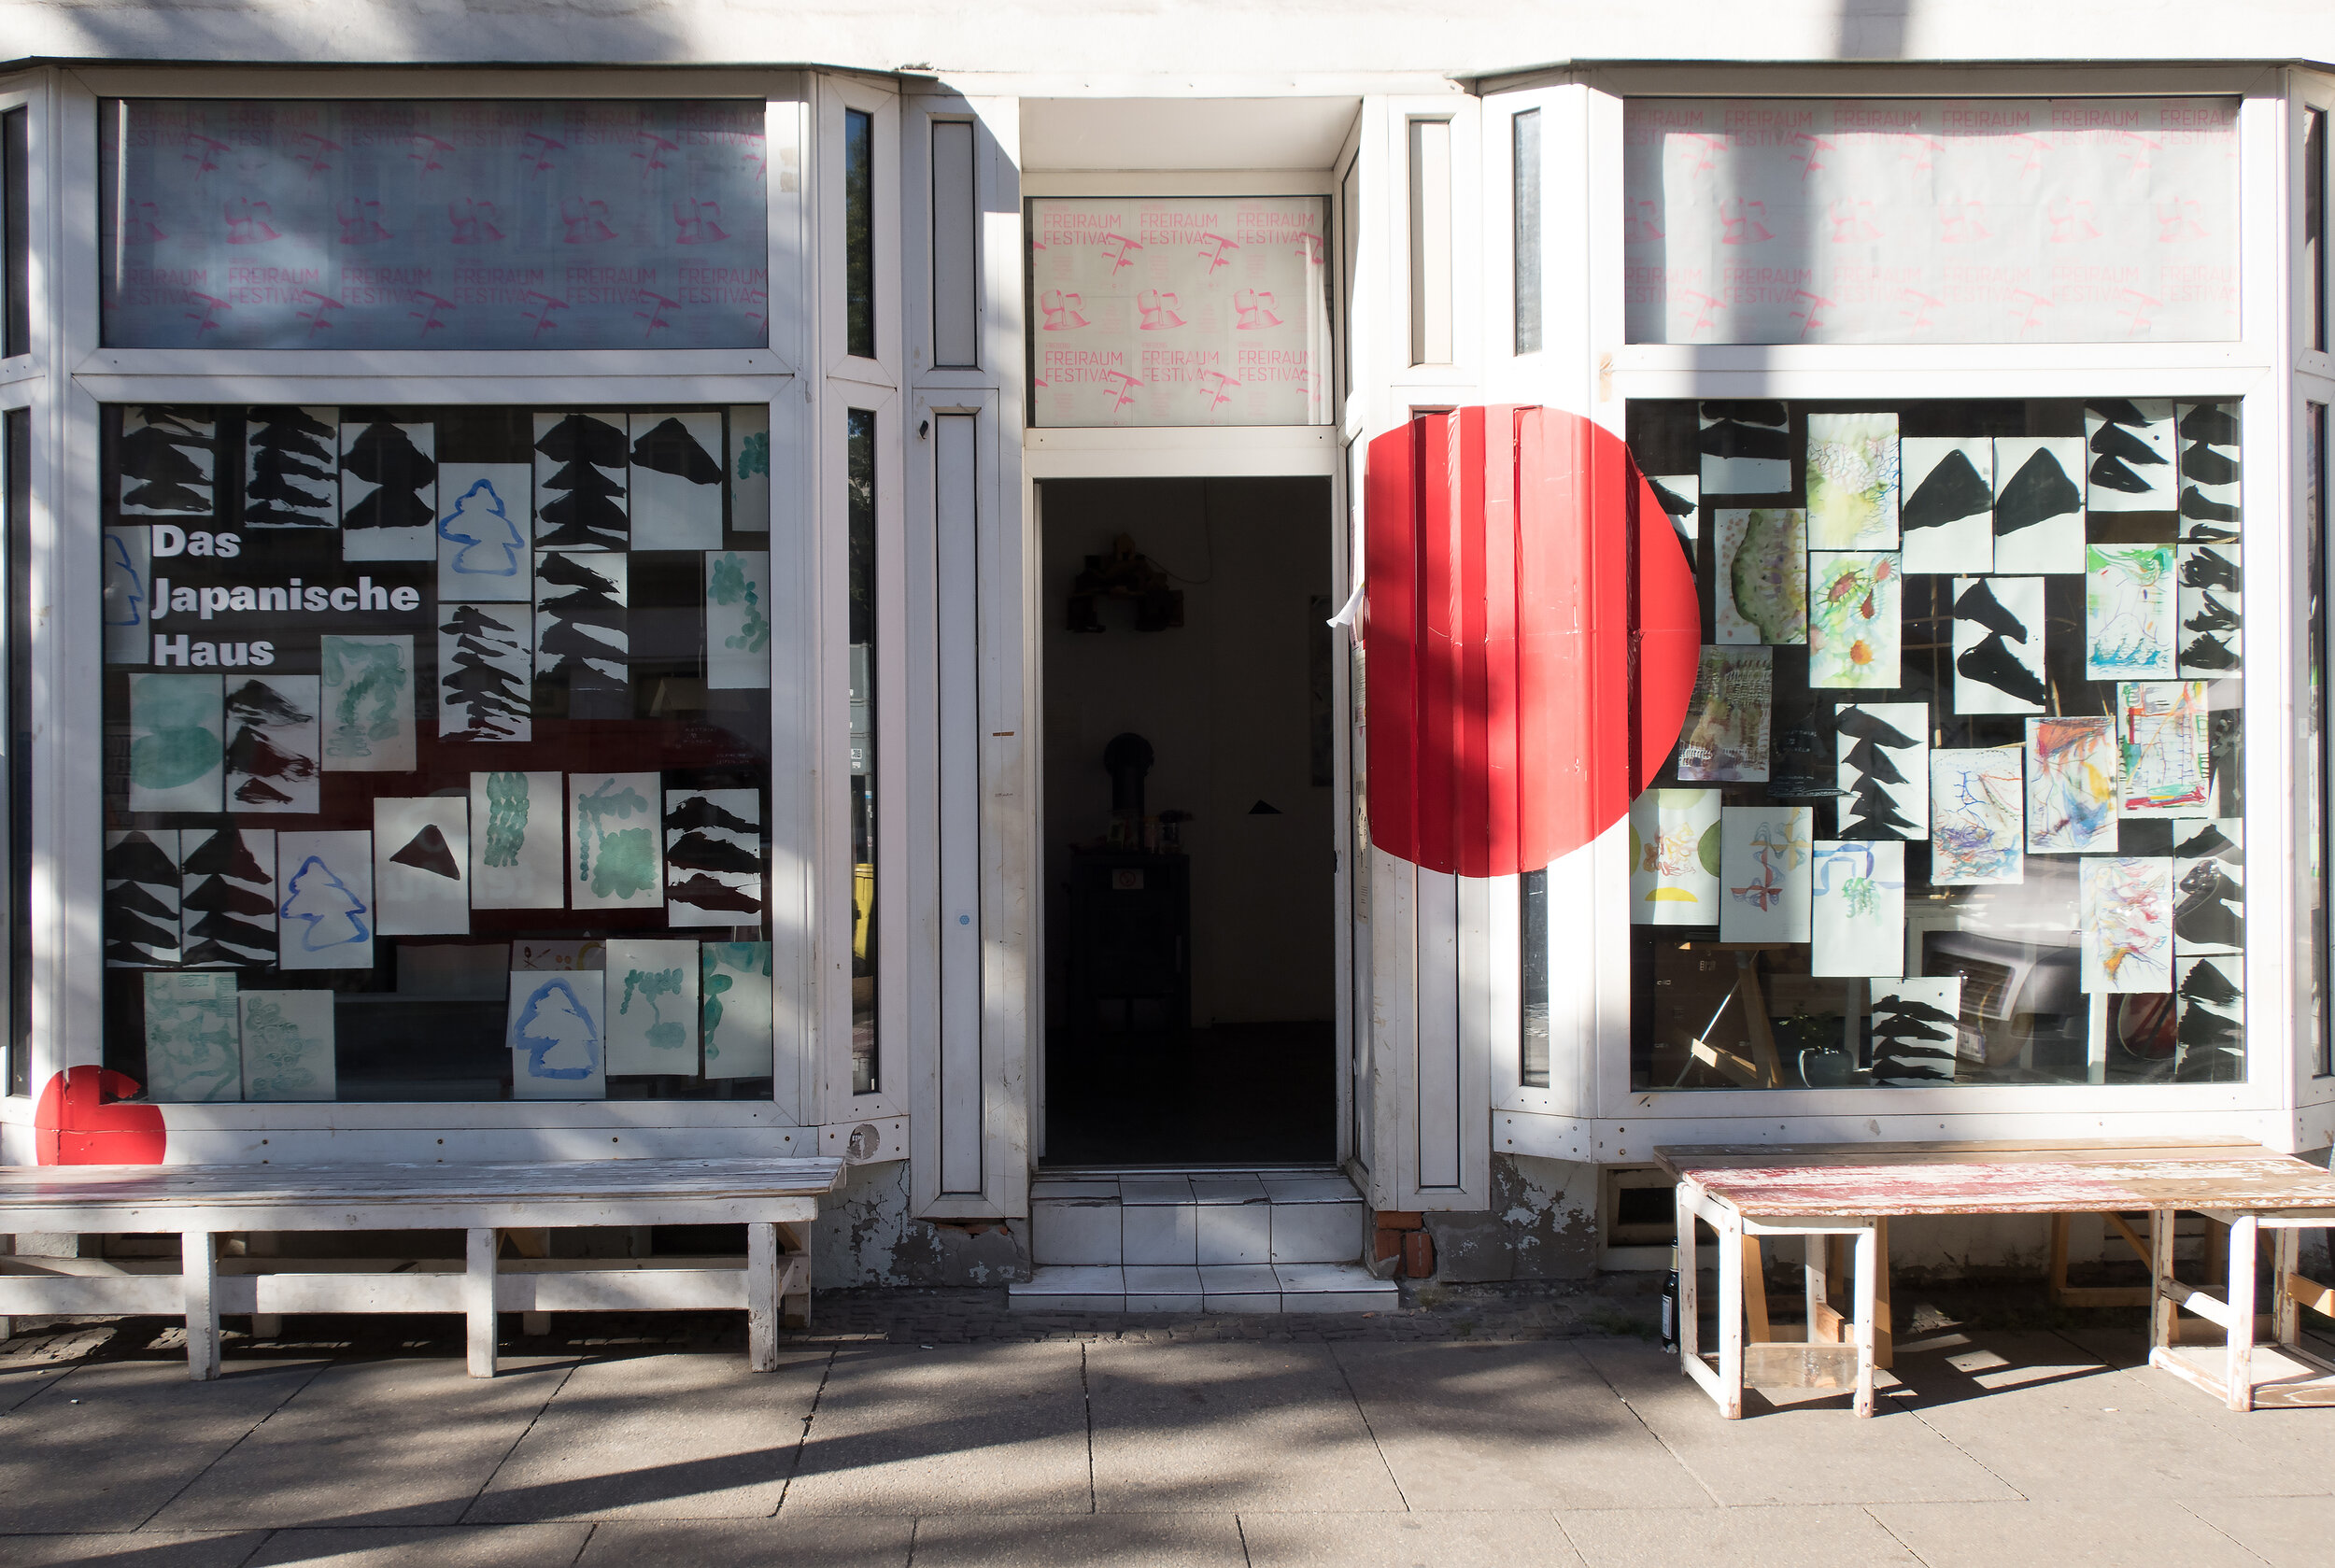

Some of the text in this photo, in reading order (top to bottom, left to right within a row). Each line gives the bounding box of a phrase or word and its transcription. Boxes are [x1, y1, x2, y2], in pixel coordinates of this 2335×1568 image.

[228, 111, 318, 128] FREIRAUM
[341, 110, 431, 128] FREIRAUM
[452, 110, 543, 128] FREIRAUM
[564, 110, 653, 128] FREIRAUM
[1626, 110, 1704, 128] REIRAUM
[1724, 110, 1812, 128] FREIRAUM
[1833, 110, 1922, 127] FREIRAUM
[1942, 110, 2031, 128] FREIRAUM
[2051, 109, 2140, 127] FREIRAUM
[2160, 108, 2236, 127] FREIRAU
[1043, 213, 1122, 229] FREIRAUM
[1139, 213, 1219, 228] FREIRAUM
[1237, 212, 1315, 228] FREIRAUM
[228, 267, 319, 285] FREIRAUM
[341, 267, 432, 285] FREIRAUM
[453, 267, 545, 285] FREIRAUM
[566, 267, 657, 285] FREIRAUM
[1626, 266, 1703, 285] REIRAUM
[1724, 267, 1812, 285] FREIRAUM
[1833, 266, 1921, 284] FREIRAUM
[1943, 266, 2031, 284] FREIRAUM
[2051, 265, 2139, 284] FREIRAUM
[1045, 350, 1123, 366] FREIRAUM
[1141, 350, 1219, 365] FREIRAUM
[1238, 350, 1316, 365] FREIRAUM
[151, 524, 242, 558] Das
[150, 576, 420, 620] Japanische
[154, 633, 276, 667] Haus
